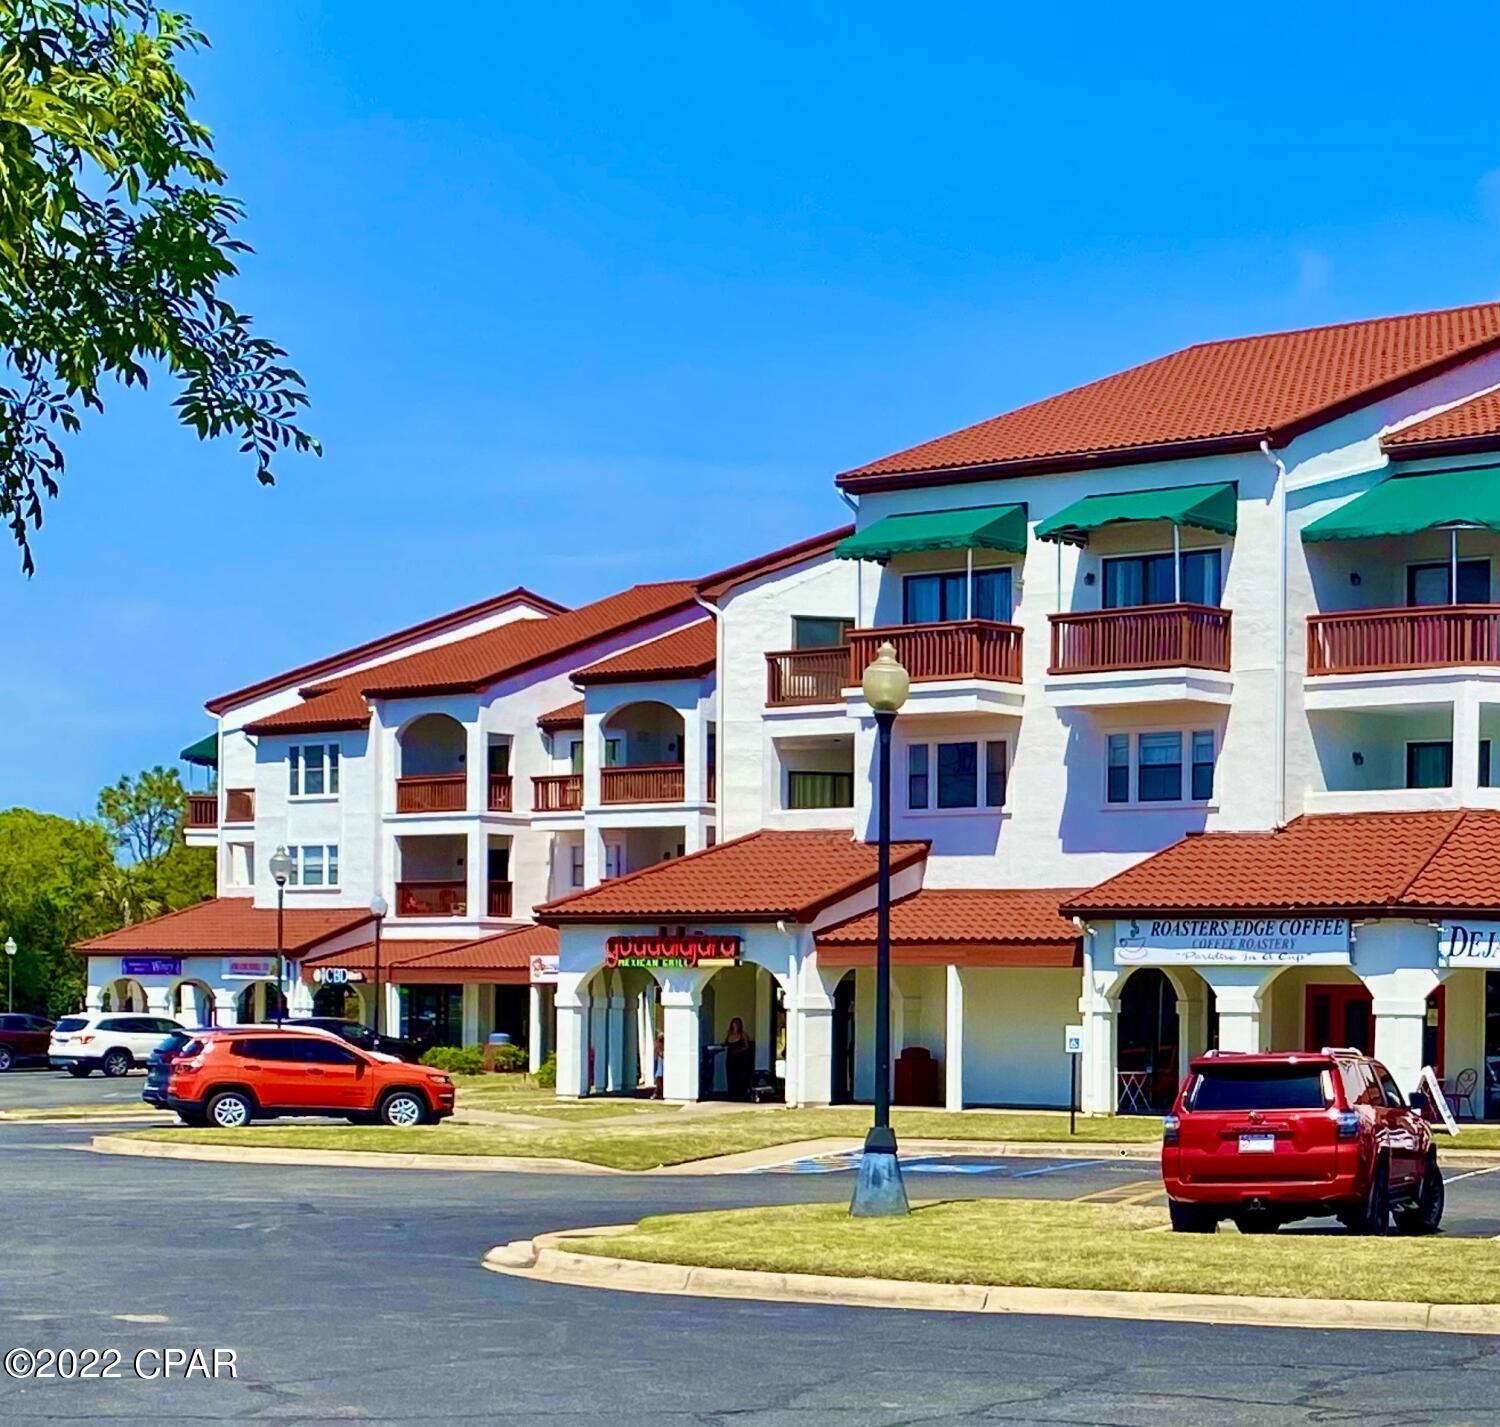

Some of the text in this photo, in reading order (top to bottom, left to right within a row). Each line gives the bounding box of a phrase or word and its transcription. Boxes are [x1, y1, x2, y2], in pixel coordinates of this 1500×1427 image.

[1151, 919, 1345, 936] ROASTERS EDGE COFFEE
[1192, 938, 1297, 950] COFFEE ROASTERY
[618, 959, 659, 968] MEXICAN
